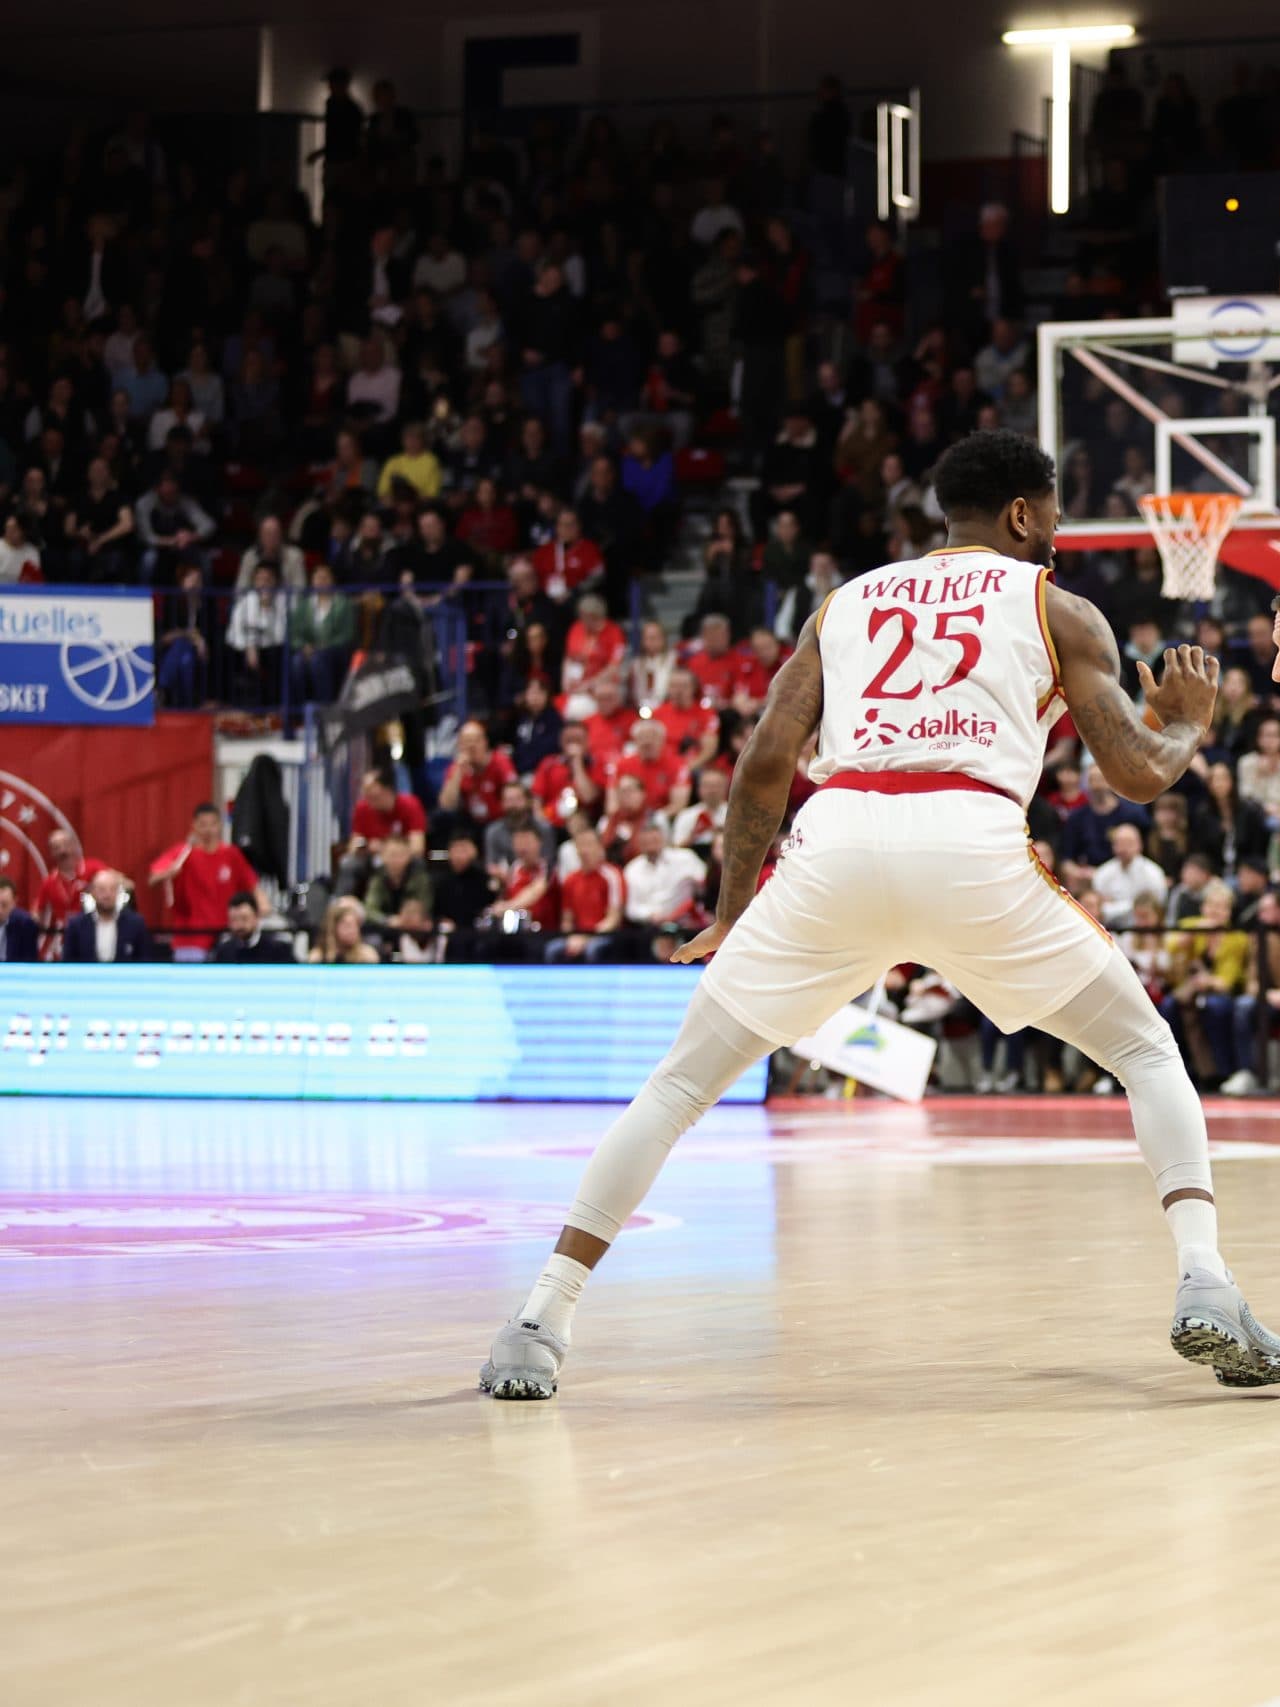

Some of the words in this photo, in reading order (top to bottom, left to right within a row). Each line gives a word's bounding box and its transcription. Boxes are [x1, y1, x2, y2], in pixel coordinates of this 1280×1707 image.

[862, 569, 1008, 605] WALKER
[861, 604, 985, 700] 25
[907, 709, 998, 740] dalkia
[83, 1008, 351, 1068] organisme
[367, 1017, 429, 1057] de
[521, 1322, 541, 1331] FREAK
